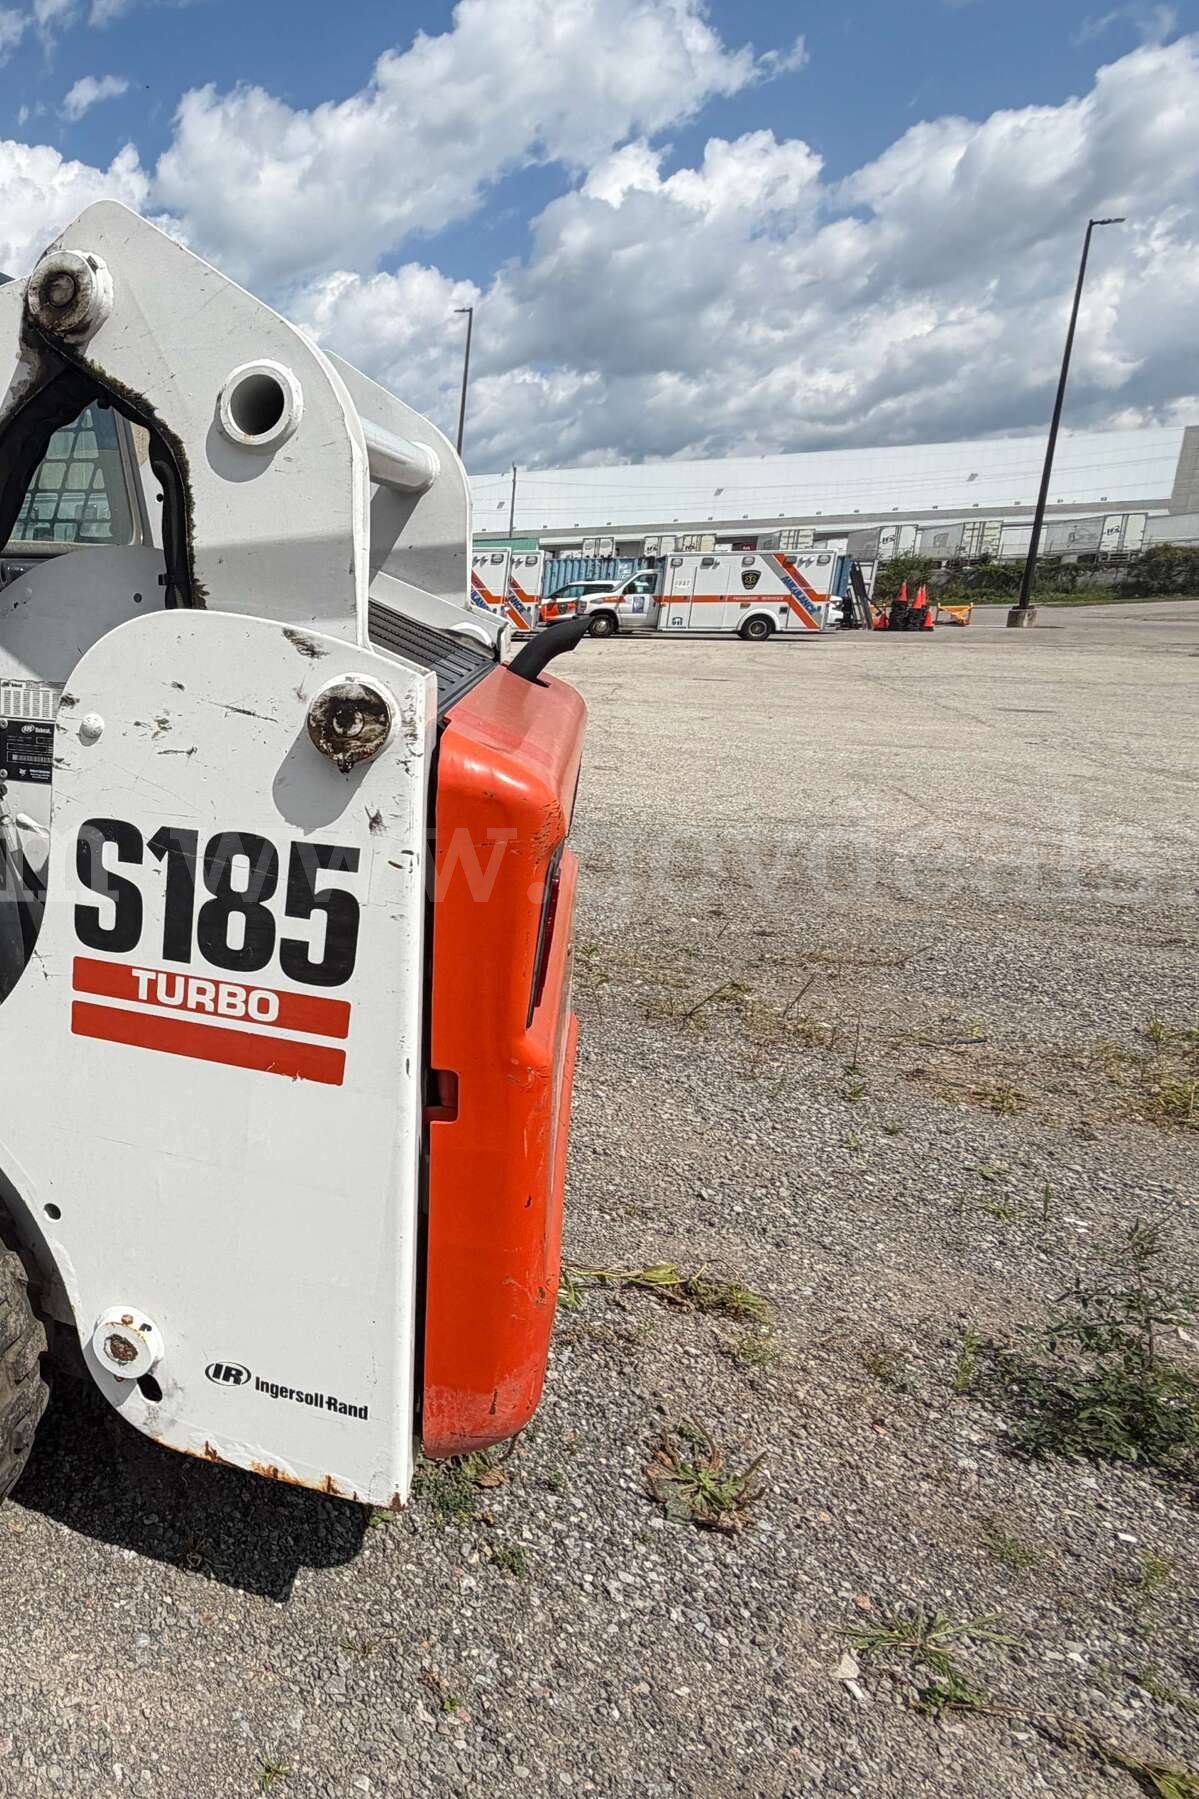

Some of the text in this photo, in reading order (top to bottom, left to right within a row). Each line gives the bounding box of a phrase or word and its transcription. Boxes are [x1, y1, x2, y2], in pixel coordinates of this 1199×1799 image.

[74, 817, 361, 988] S185
[130, 968, 280, 1022] TURBO
[211, 1363, 245, 1386] IR
